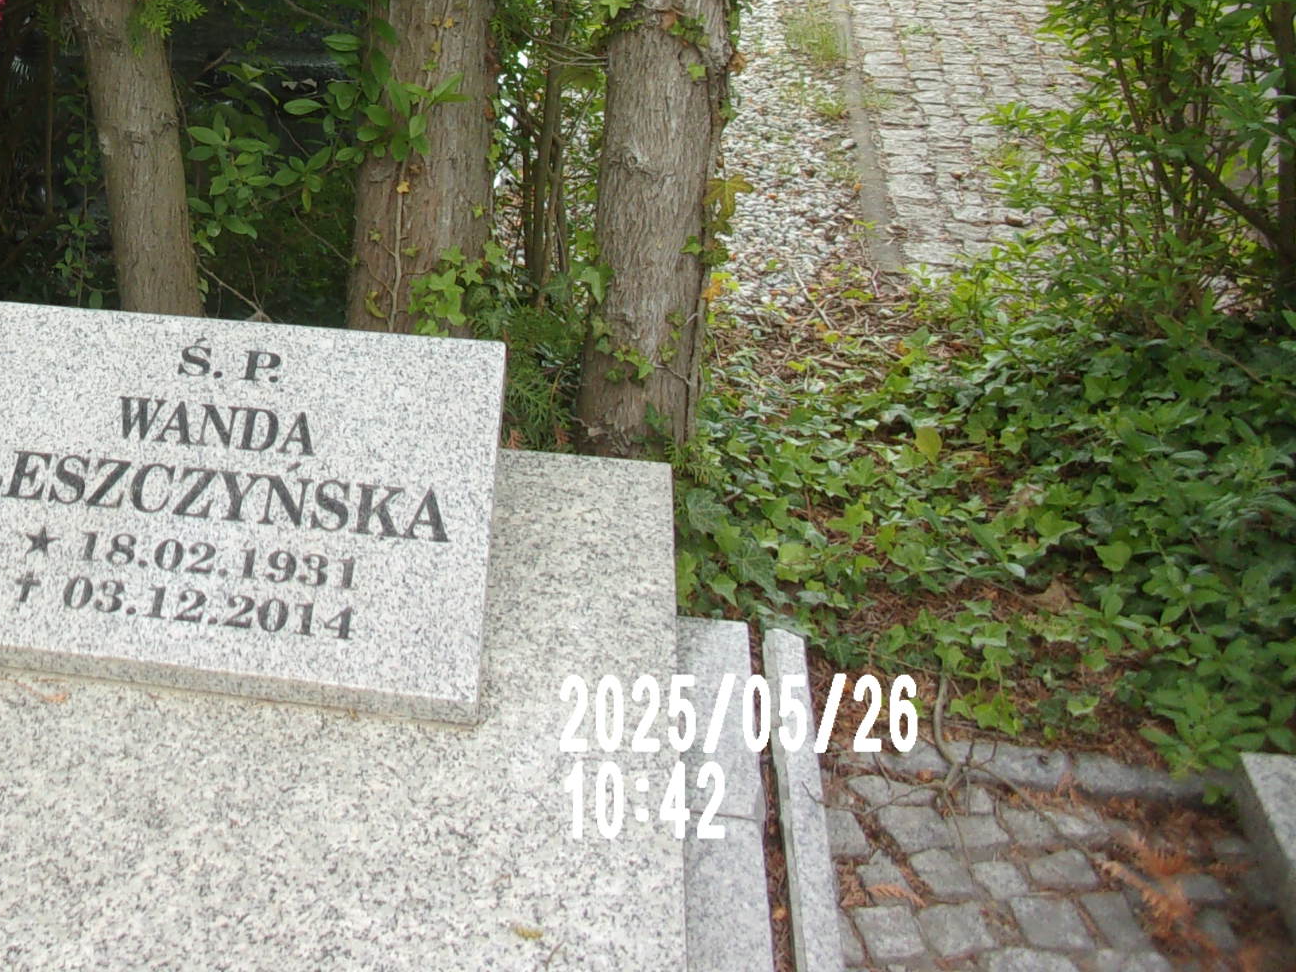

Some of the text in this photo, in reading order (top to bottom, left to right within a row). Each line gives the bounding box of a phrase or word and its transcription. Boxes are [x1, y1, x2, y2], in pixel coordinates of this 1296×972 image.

[178, 337, 280, 383] Ś. P.
[120, 395, 315, 456] WANDA
[81, 531, 357, 591] 18.02.1931
[62, 573, 354, 642] 03.12.2014
